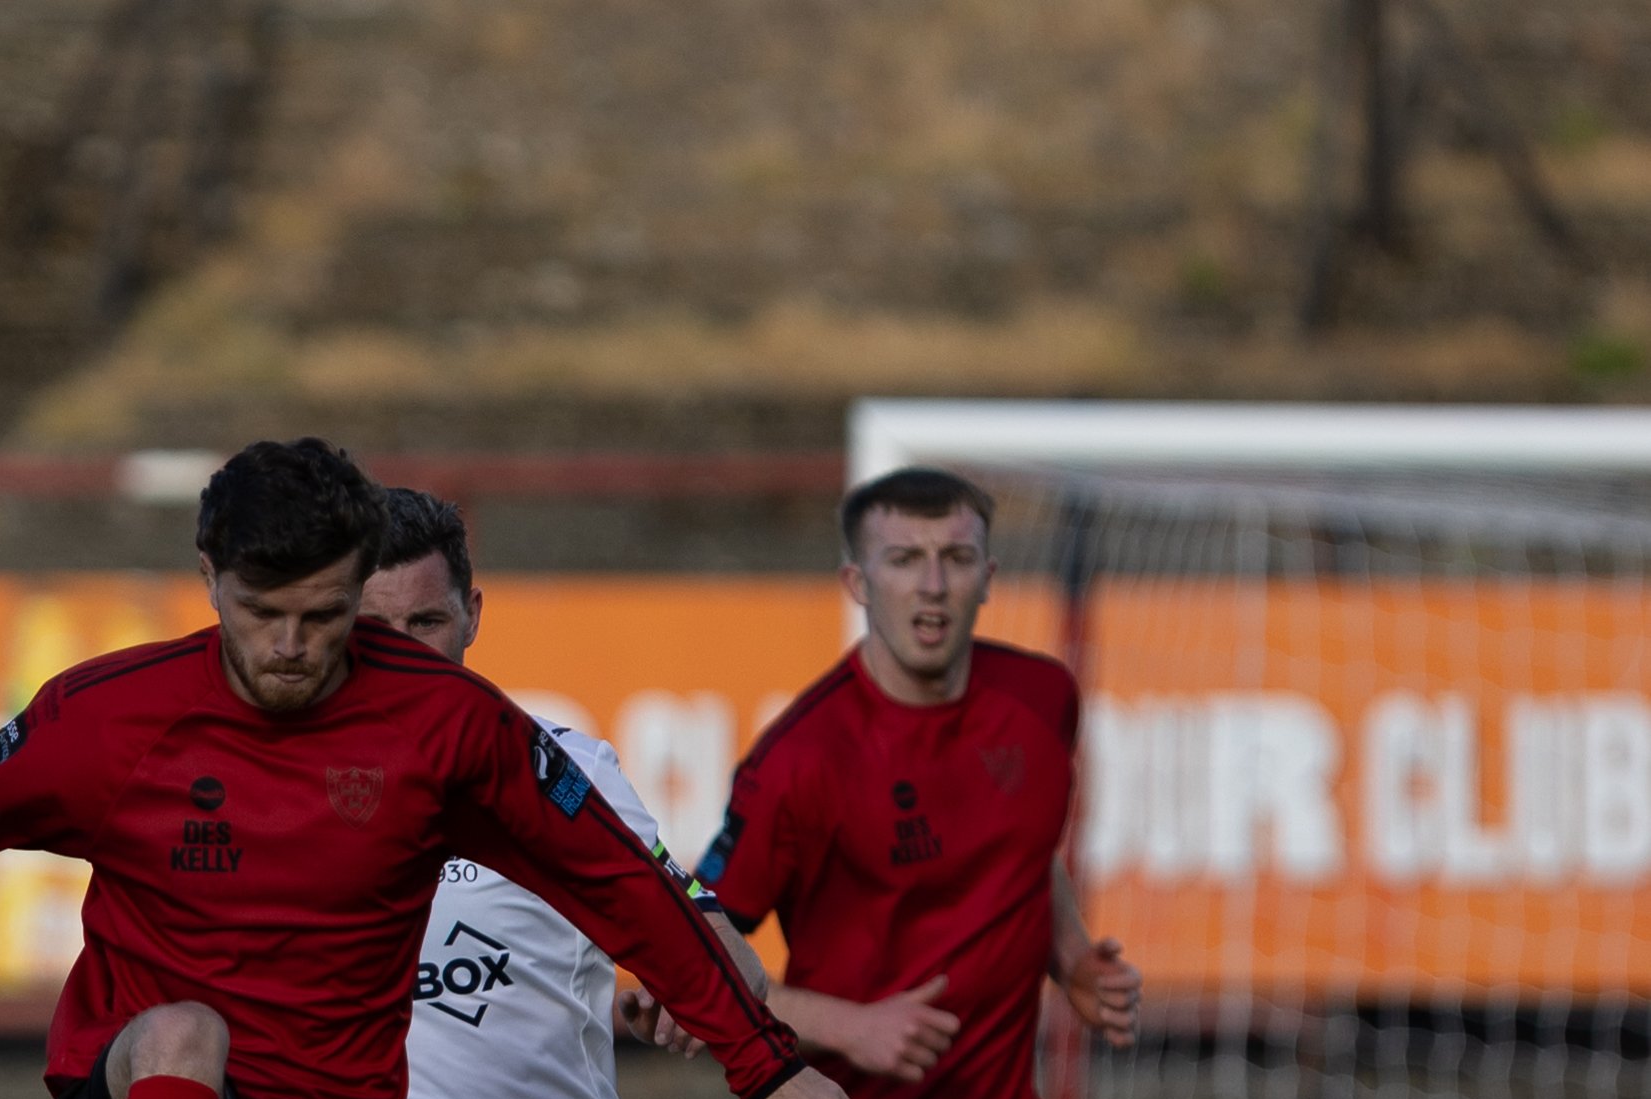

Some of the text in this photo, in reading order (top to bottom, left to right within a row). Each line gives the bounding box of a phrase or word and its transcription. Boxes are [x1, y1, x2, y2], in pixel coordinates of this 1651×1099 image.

[183, 819, 232, 845] DES
[170, 846, 242, 873] KELLY
[437, 863, 479, 883] 930
